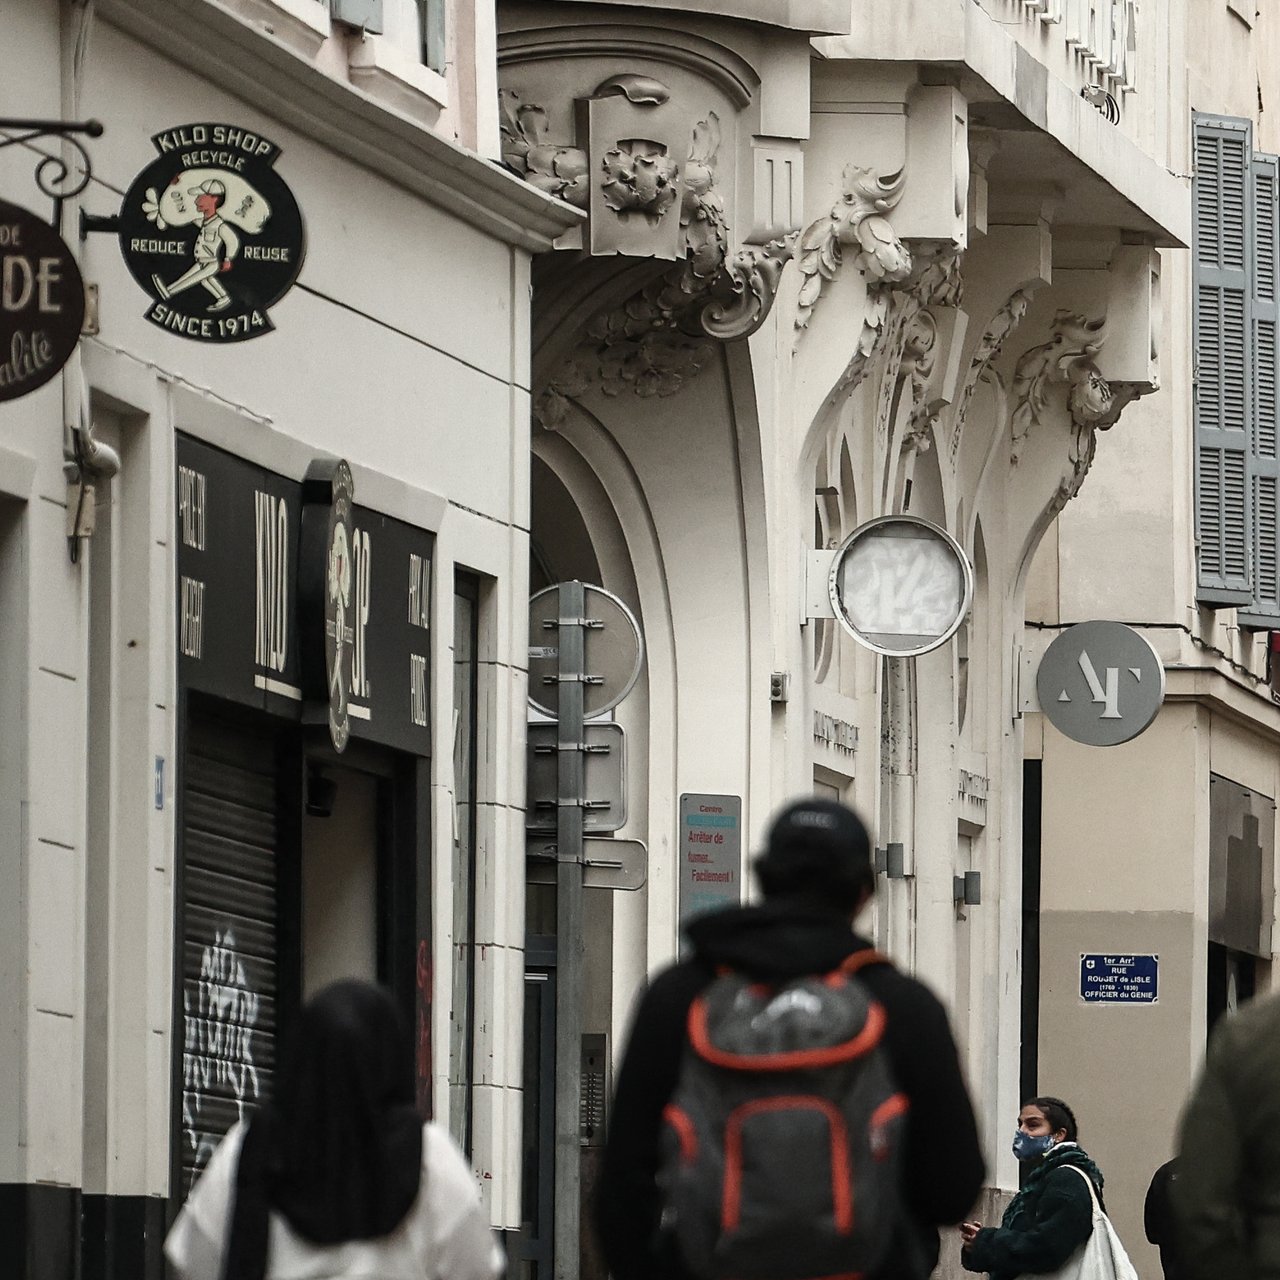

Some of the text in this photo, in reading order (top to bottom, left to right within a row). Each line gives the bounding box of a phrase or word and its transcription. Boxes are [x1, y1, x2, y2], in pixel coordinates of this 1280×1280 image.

[157, 126, 271, 156] KILO SHOP
[181, 150, 246, 172] RECYCLE
[131, 238, 186, 255] REDUCE
[244, 246, 289, 262] REUSE
[151, 303, 265, 337] SINCE 1974
[255, 490, 288, 673] KILO
[688, 831, 724, 844] Arrêter de
[691, 869, 729, 883] Facilement
